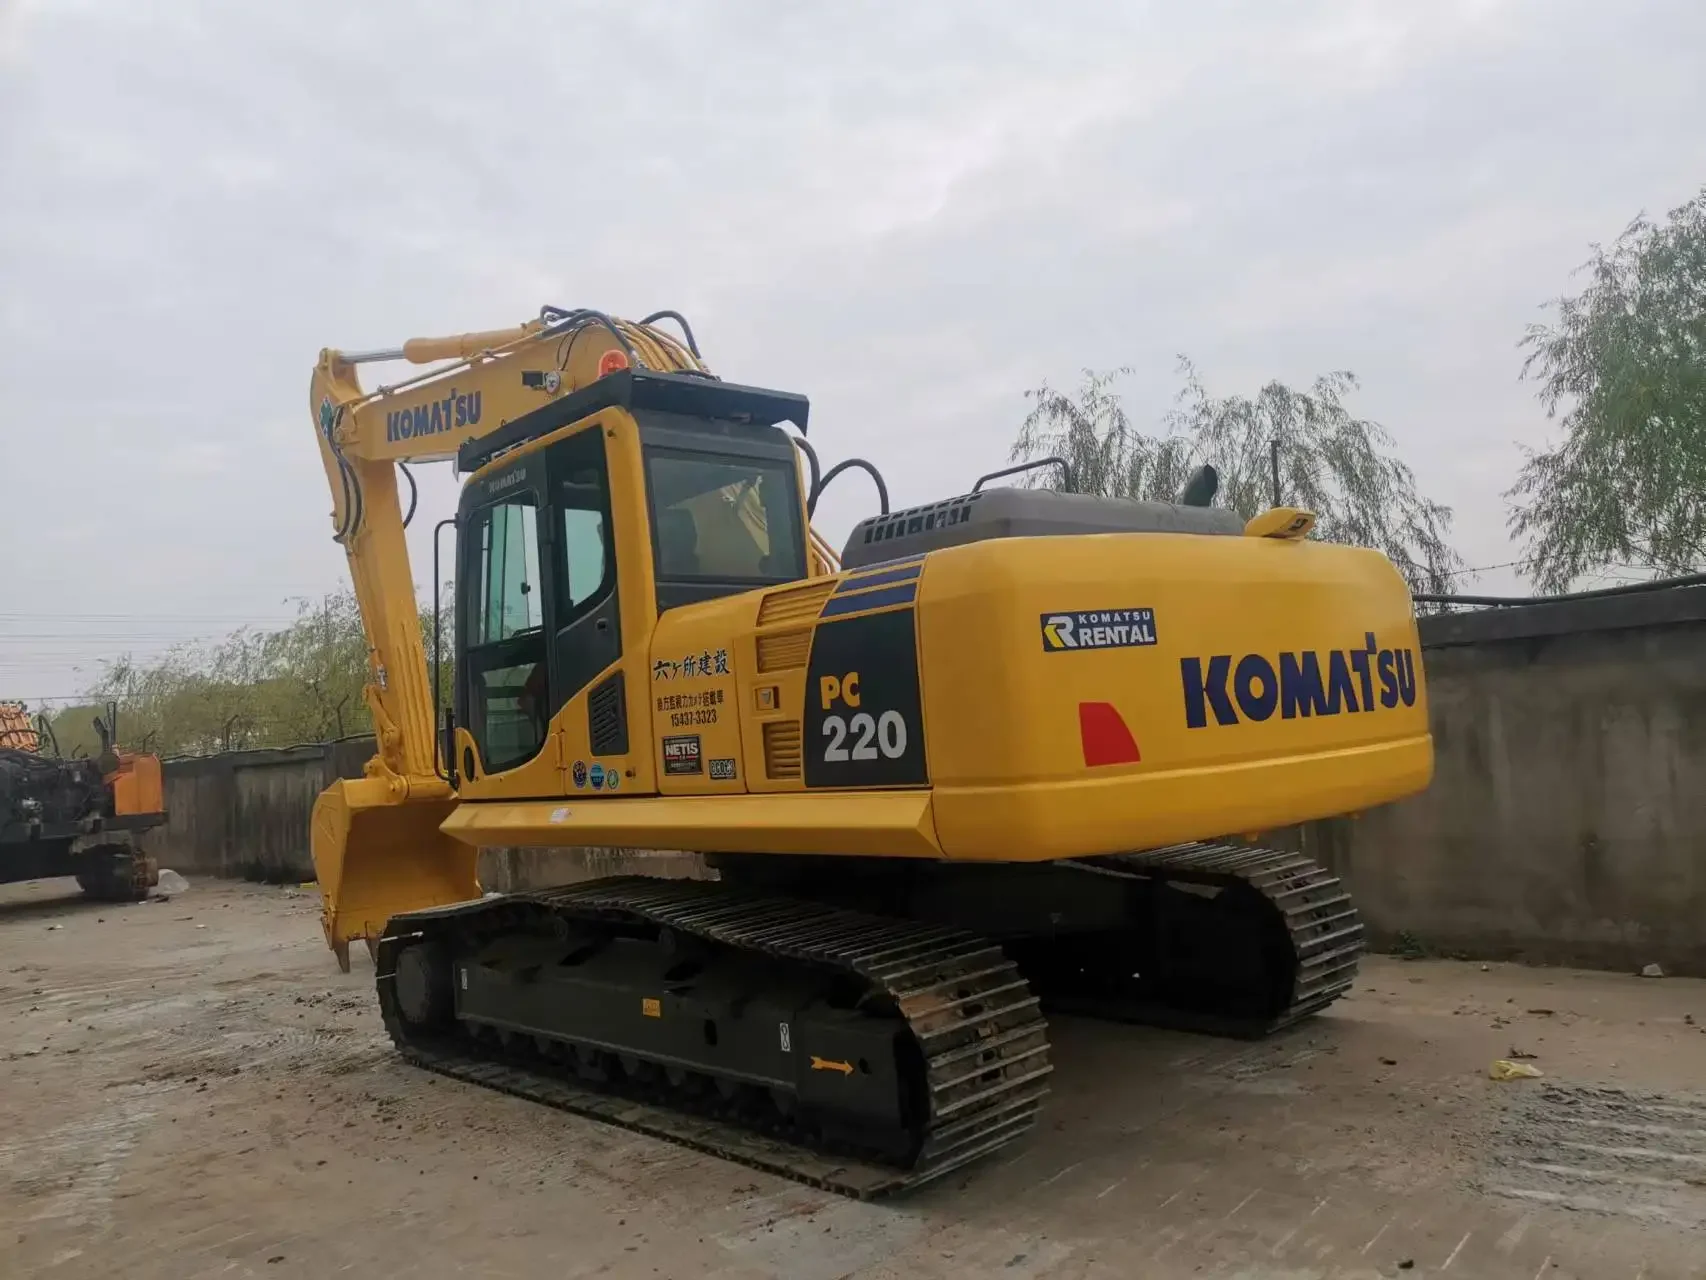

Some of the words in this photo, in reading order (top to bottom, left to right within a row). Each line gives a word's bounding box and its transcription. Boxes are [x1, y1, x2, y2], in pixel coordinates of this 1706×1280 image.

[387, 388, 481, 442] KOMATSU
[1078, 611, 1151, 624] KOMATSU
[1079, 625, 1156, 647] RENTAL
[820, 671, 861, 710] PC
[1180, 632, 1417, 729] KOMATSU
[670, 709, 718, 728] 15437-3323
[665, 742, 699, 756] NETIS
[822, 710, 908, 762] 220
